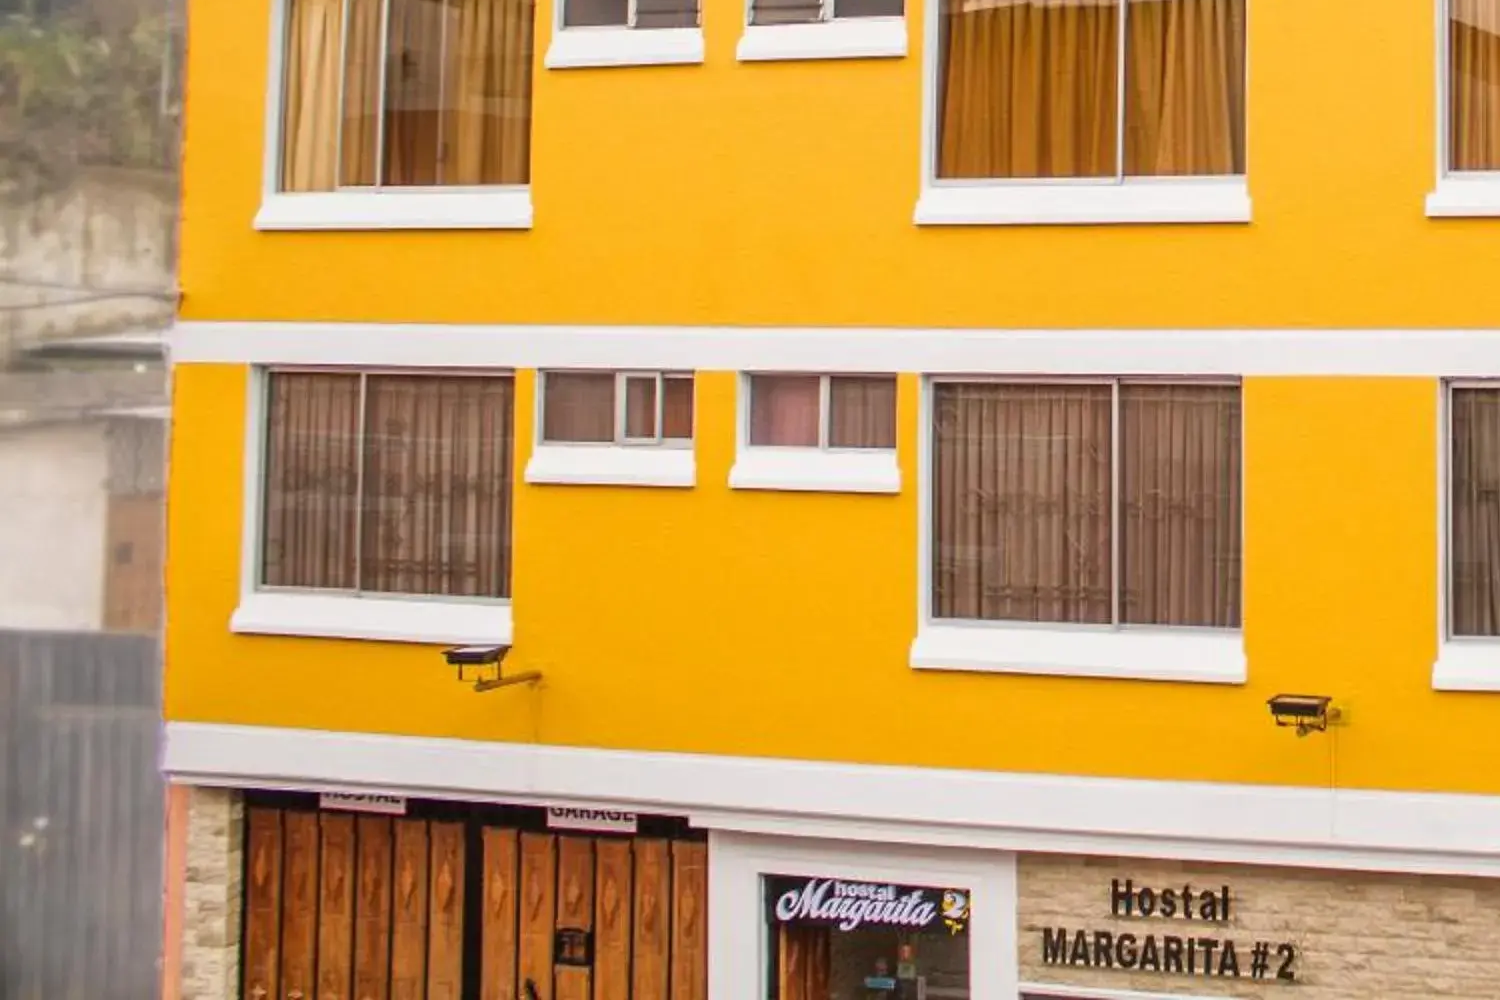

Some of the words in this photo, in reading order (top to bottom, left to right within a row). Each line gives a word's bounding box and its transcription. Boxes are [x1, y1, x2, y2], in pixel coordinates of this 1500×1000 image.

[776, 878, 936, 931] Margarita
[943, 890, 967, 919] 2
[834, 881, 897, 900] hostal
[1111, 878, 1229, 921] Hostal
[1042, 927, 1240, 978] MARGARITA
[1251, 941, 1295, 980] #2
